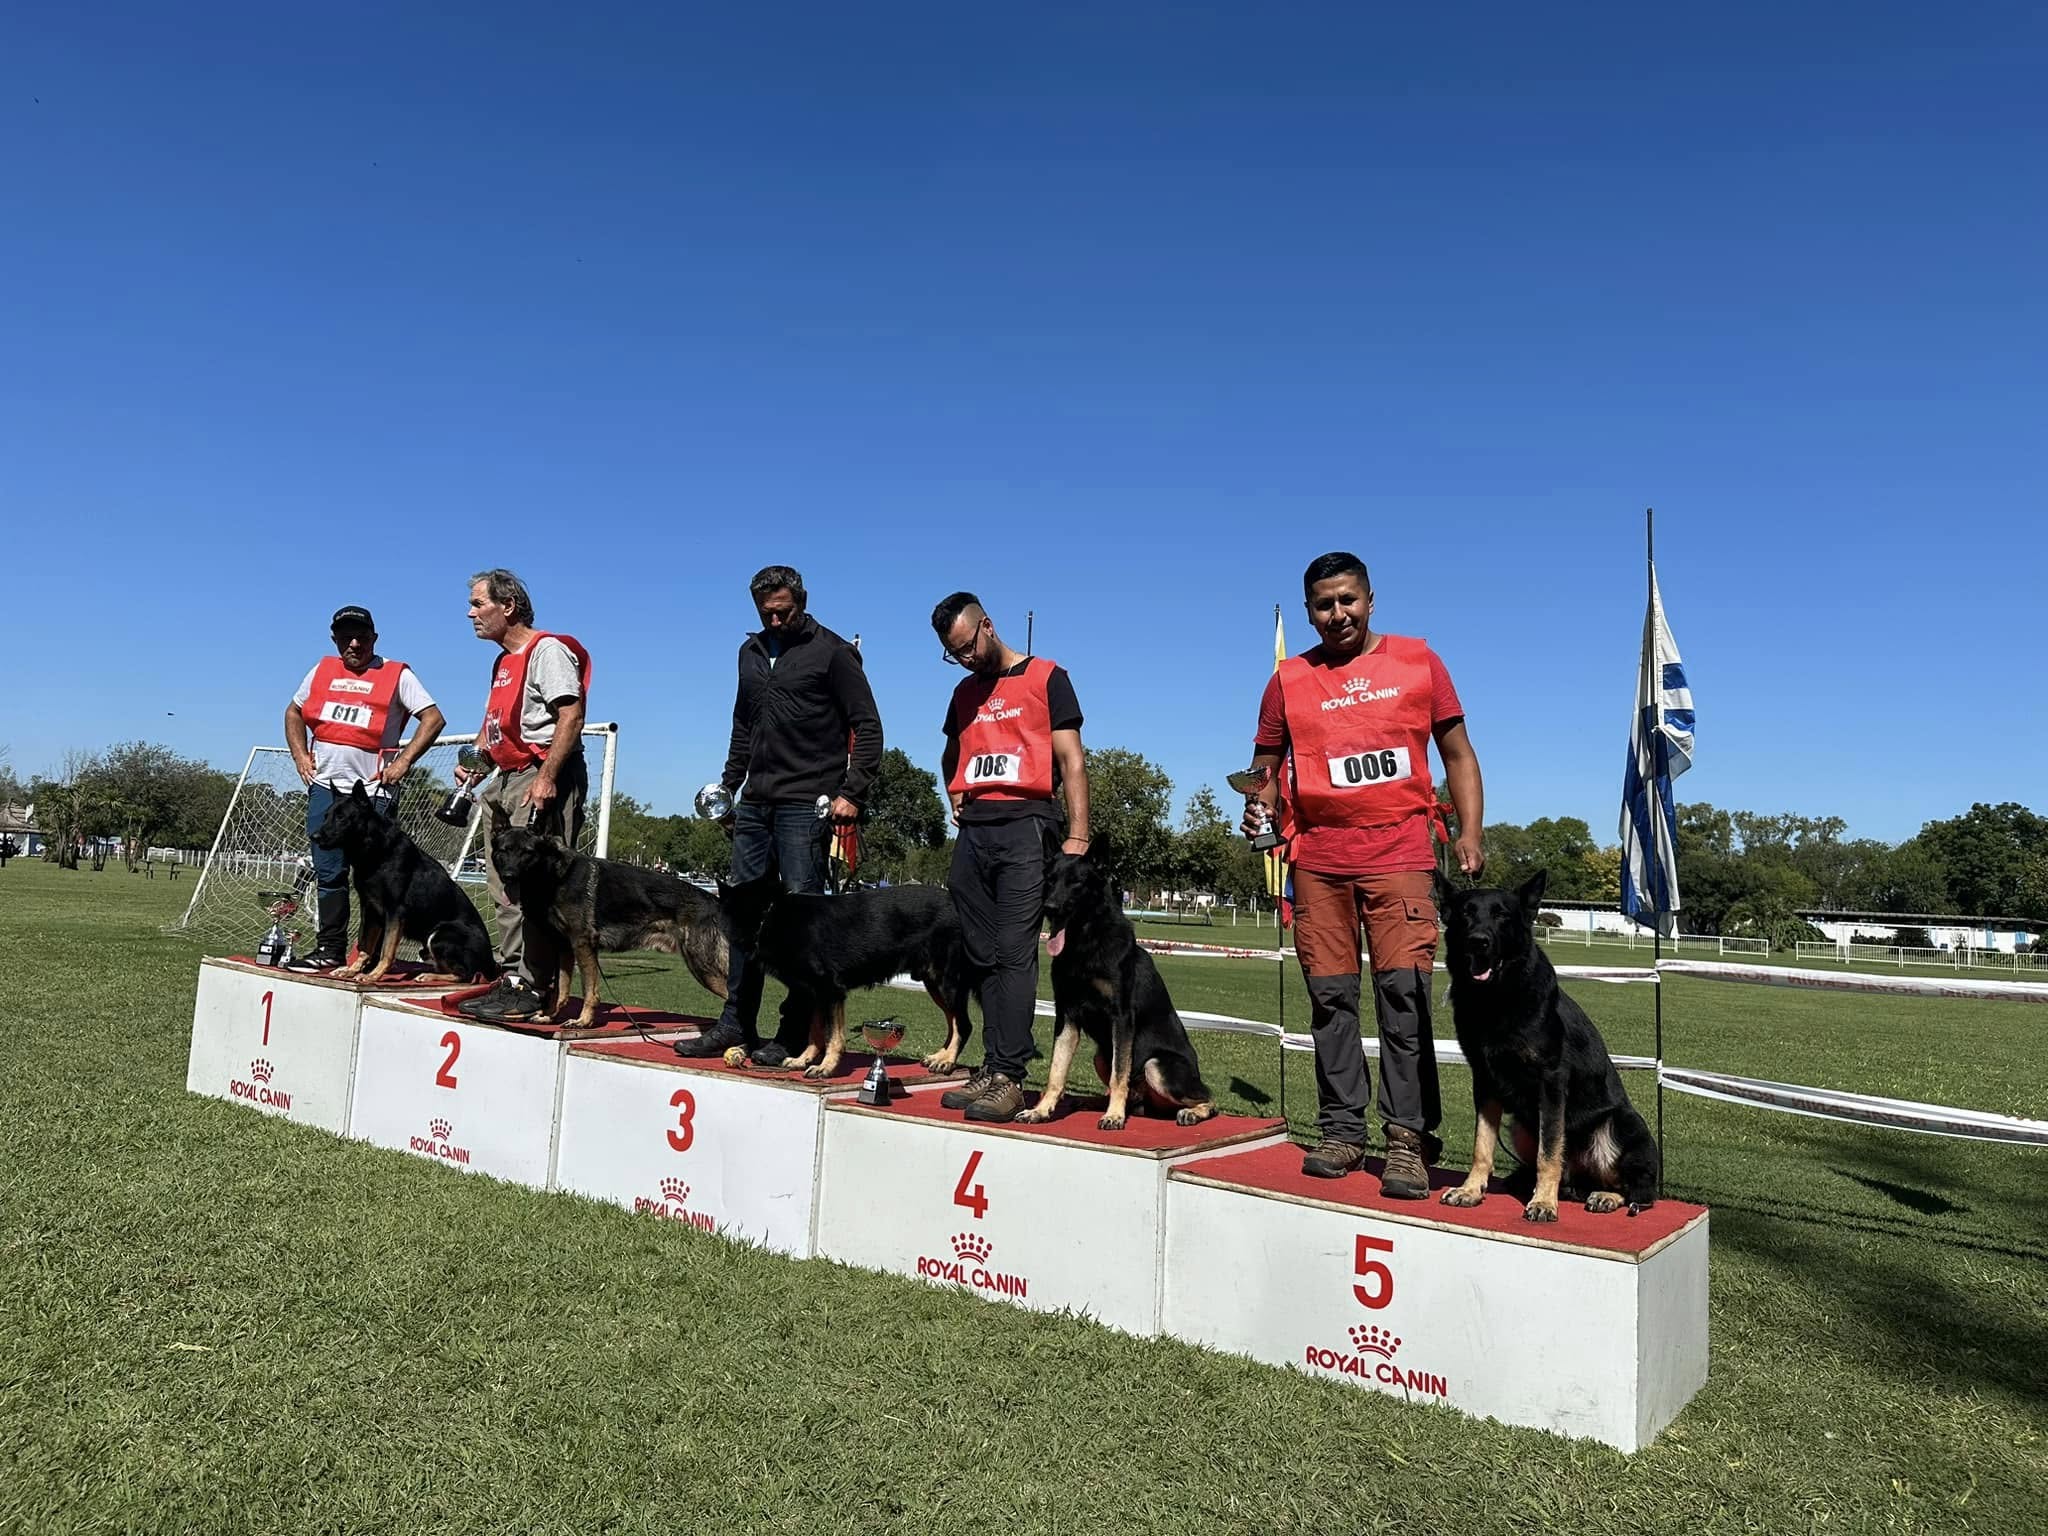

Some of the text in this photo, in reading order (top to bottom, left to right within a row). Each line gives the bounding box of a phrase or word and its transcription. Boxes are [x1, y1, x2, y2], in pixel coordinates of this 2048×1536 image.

[996, 707, 1021, 721] CANIN
[1321, 687, 1399, 711] ROYAL CANIN
[1344, 750, 1398, 783] 006
[261, 991, 274, 1046] 1
[435, 1031, 462, 1089] 2
[230, 1079, 291, 1111] ROYAL CANIN
[666, 1089, 696, 1152] 3
[410, 1136, 470, 1164] ROYAL CANIN
[953, 1151, 989, 1219] 4
[673, 1207, 714, 1233] CANIN
[917, 1256, 1027, 1298] ROYAL CANIN
[1353, 1234, 1394, 1310] 5
[1306, 1346, 1447, 1397] ROYAL CANIN
